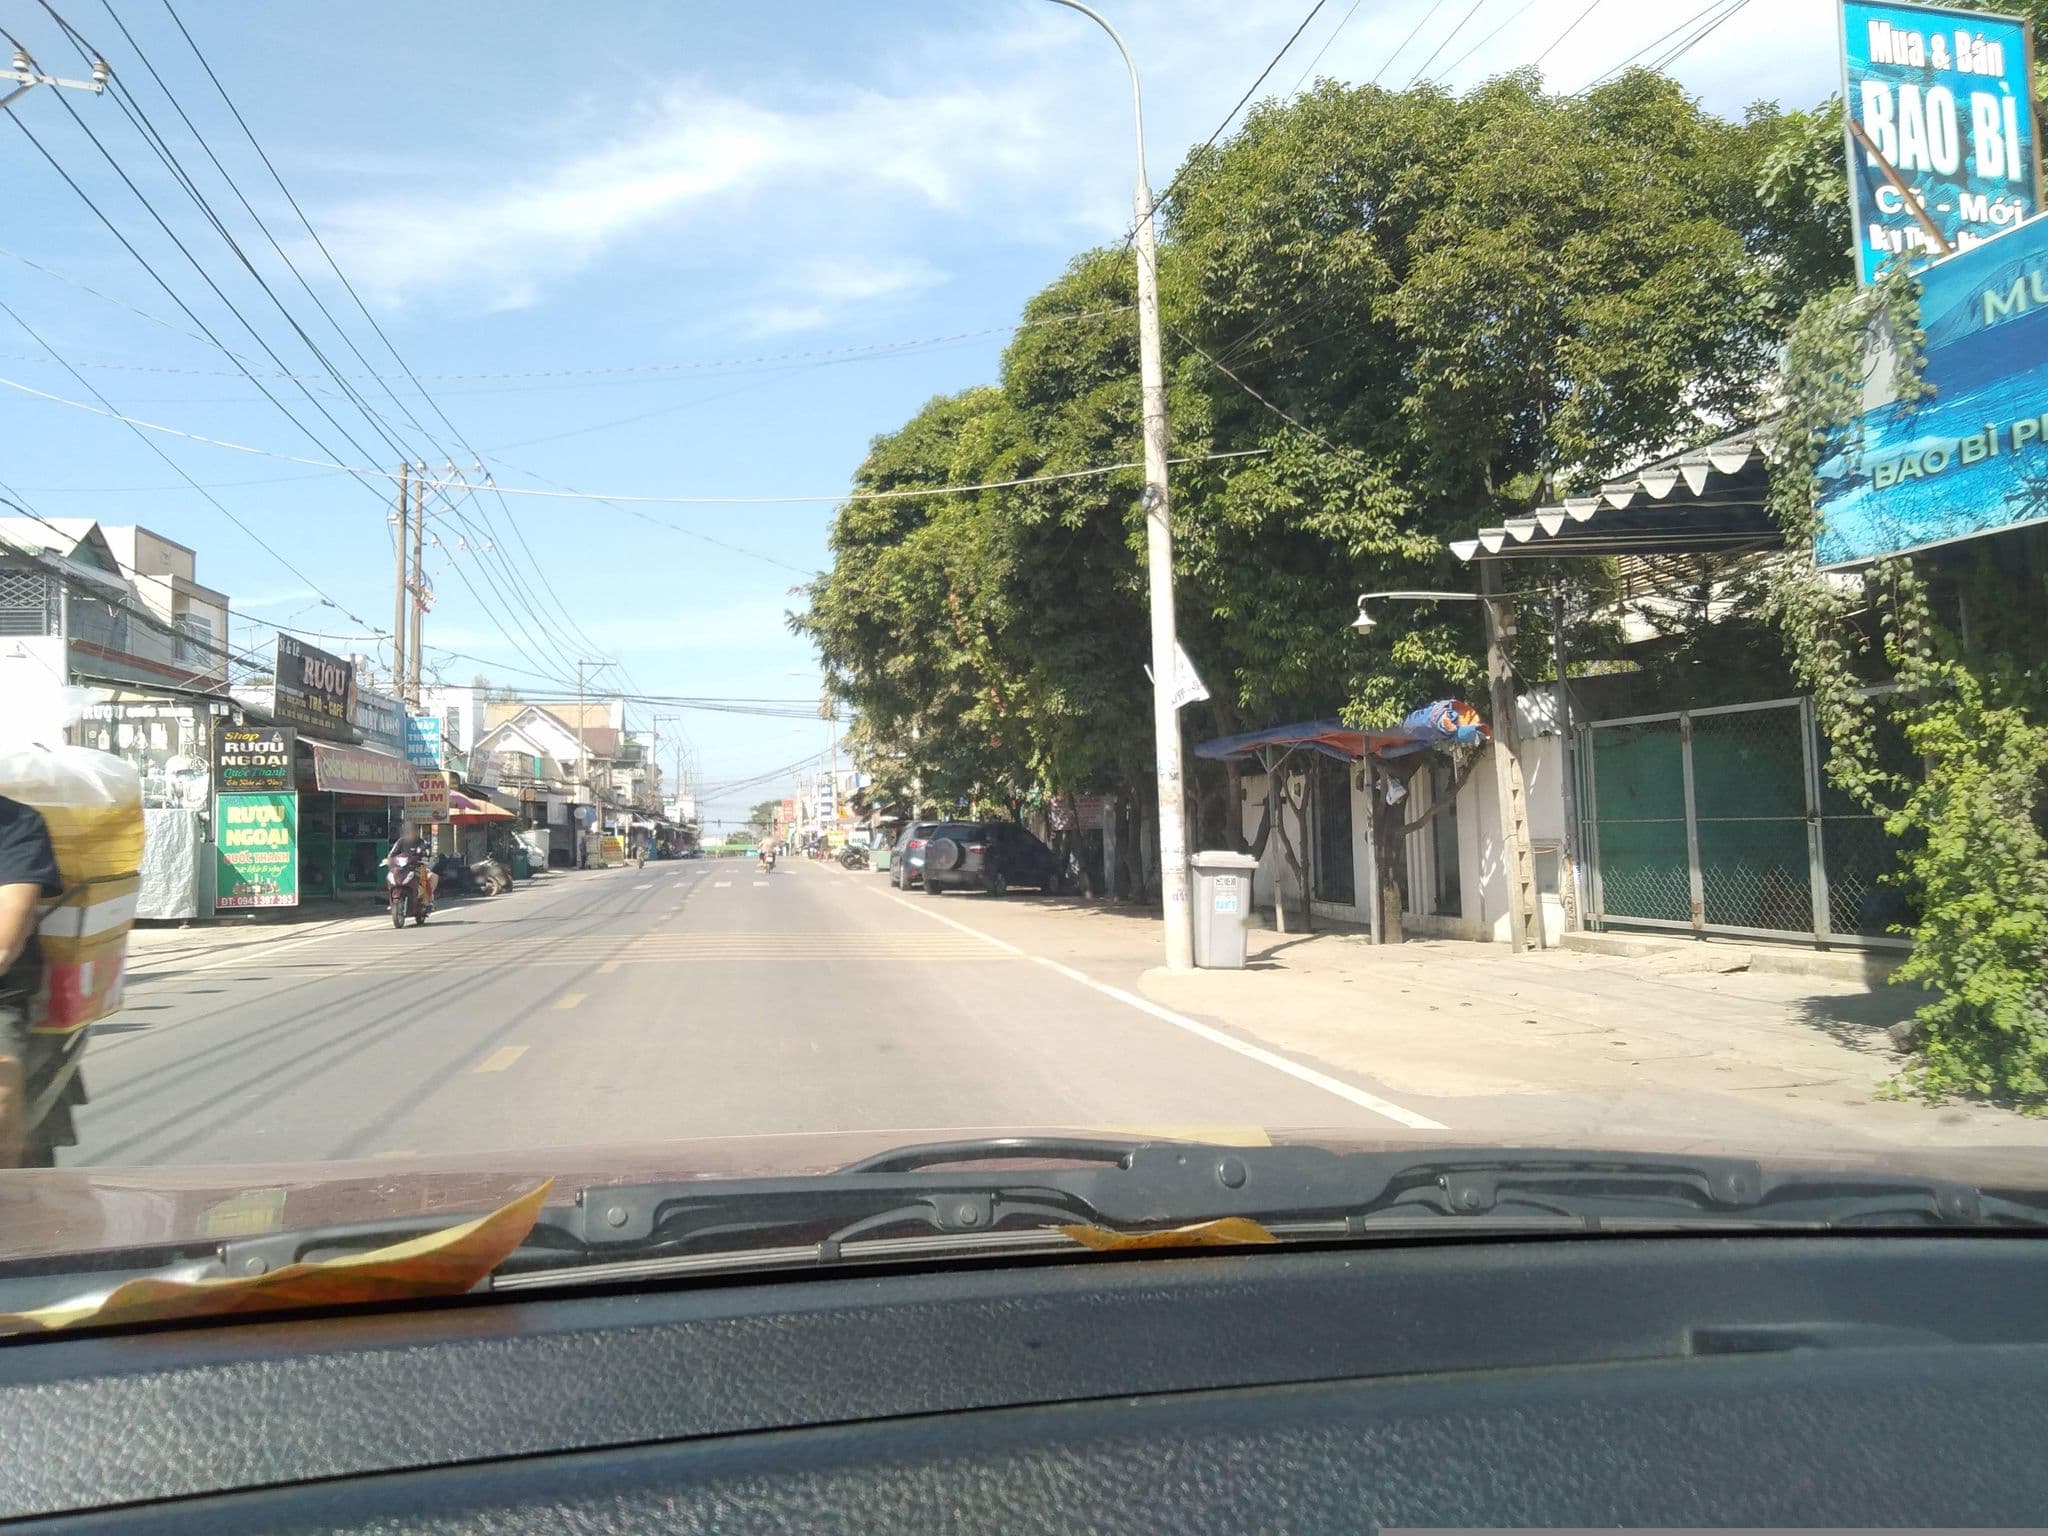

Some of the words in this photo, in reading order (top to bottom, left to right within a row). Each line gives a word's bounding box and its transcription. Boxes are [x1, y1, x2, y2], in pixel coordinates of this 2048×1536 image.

[1867, 20, 1926, 68] Mua
[1930, 33, 1950, 71] &
[1954, 31, 2004, 77] Bán
[1860, 80, 1960, 176] BAO
[1971, 81, 2023, 182] BÌ
[1959, 193, 2024, 226] Mới
[1874, 448, 1951, 490] BAO
[1961, 422, 1999, 466] BÌ
[303, 655, 346, 700] RƯỢU
[225, 731, 260, 742] Shop
[225, 741, 284, 753] RƯỢU
[221, 755, 288, 767] NGOẠI
[227, 805, 285, 827] RƯỢU
[226, 828, 289, 849] NGOẠI
